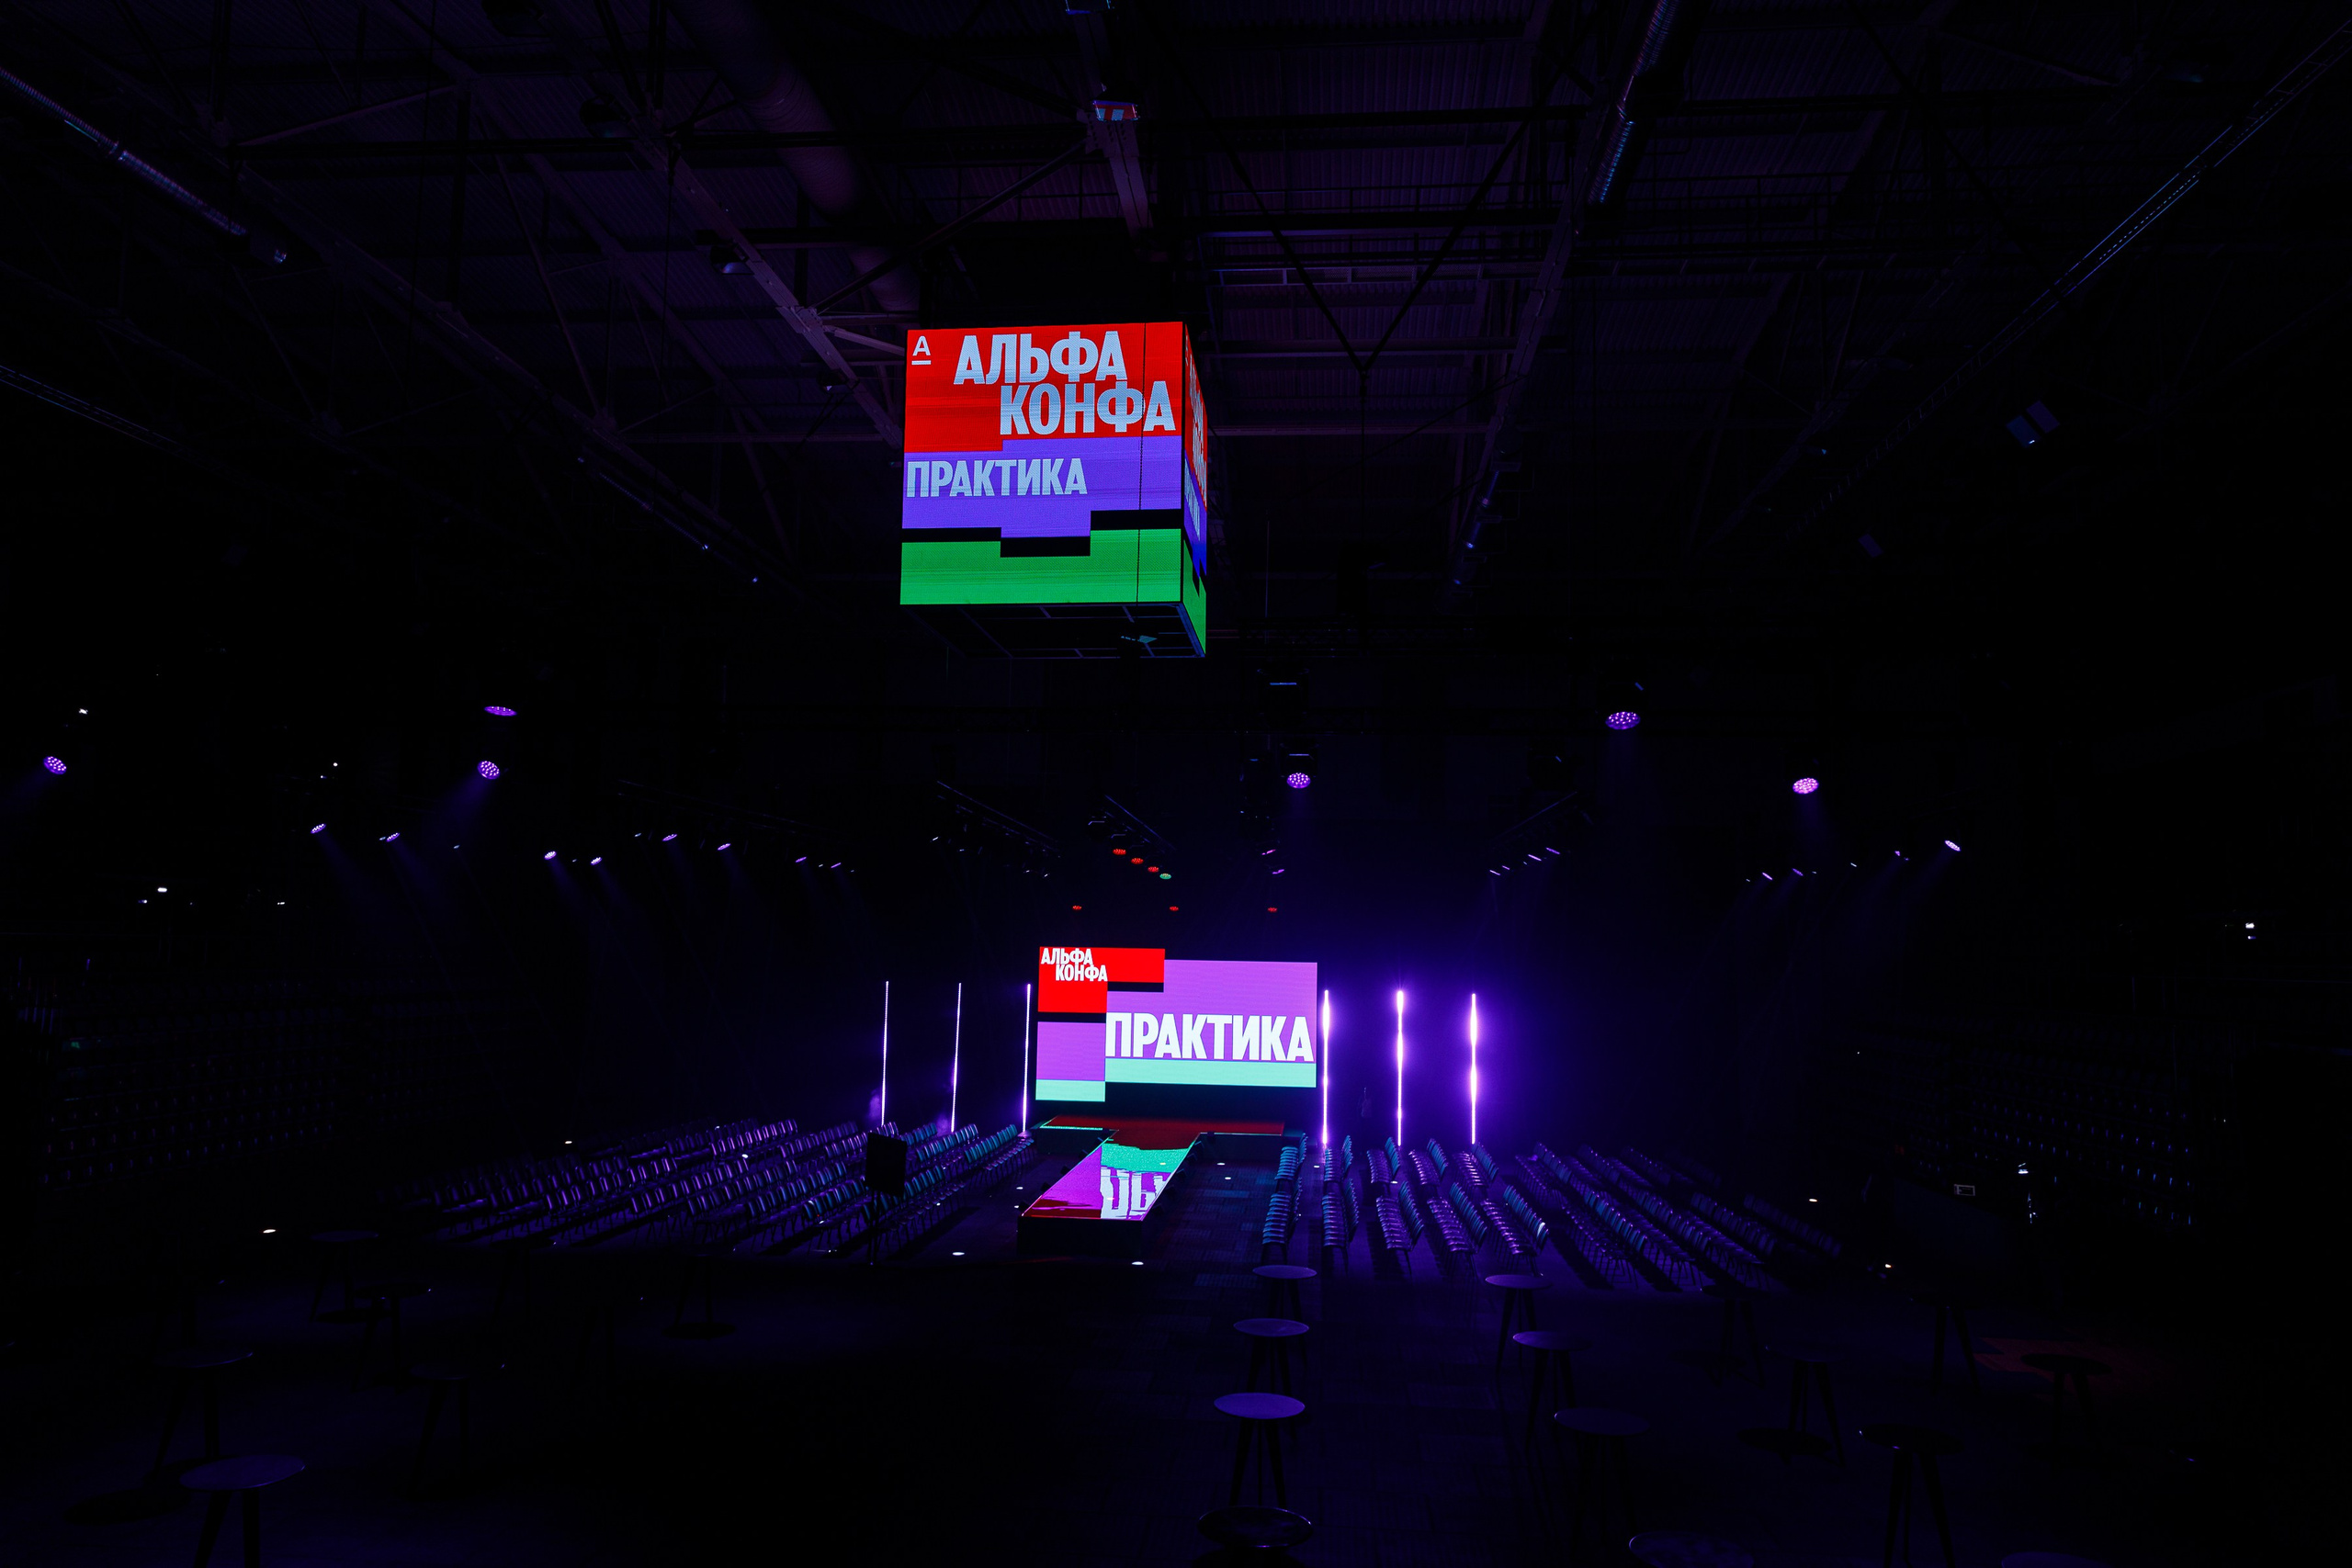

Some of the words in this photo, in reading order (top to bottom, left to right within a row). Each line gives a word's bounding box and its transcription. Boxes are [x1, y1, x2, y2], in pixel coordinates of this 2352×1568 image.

[954, 331, 1127, 384] АЛЬФА
[1000, 380, 1176, 434] КОНФА
[907, 458, 1088, 498] ПРАКТИКА
[1040, 947, 1094, 964] АЛЬФА
[1055, 964, 1108, 982] КОНФА
[1105, 1012, 1314, 1062] ПРАКТИКА
